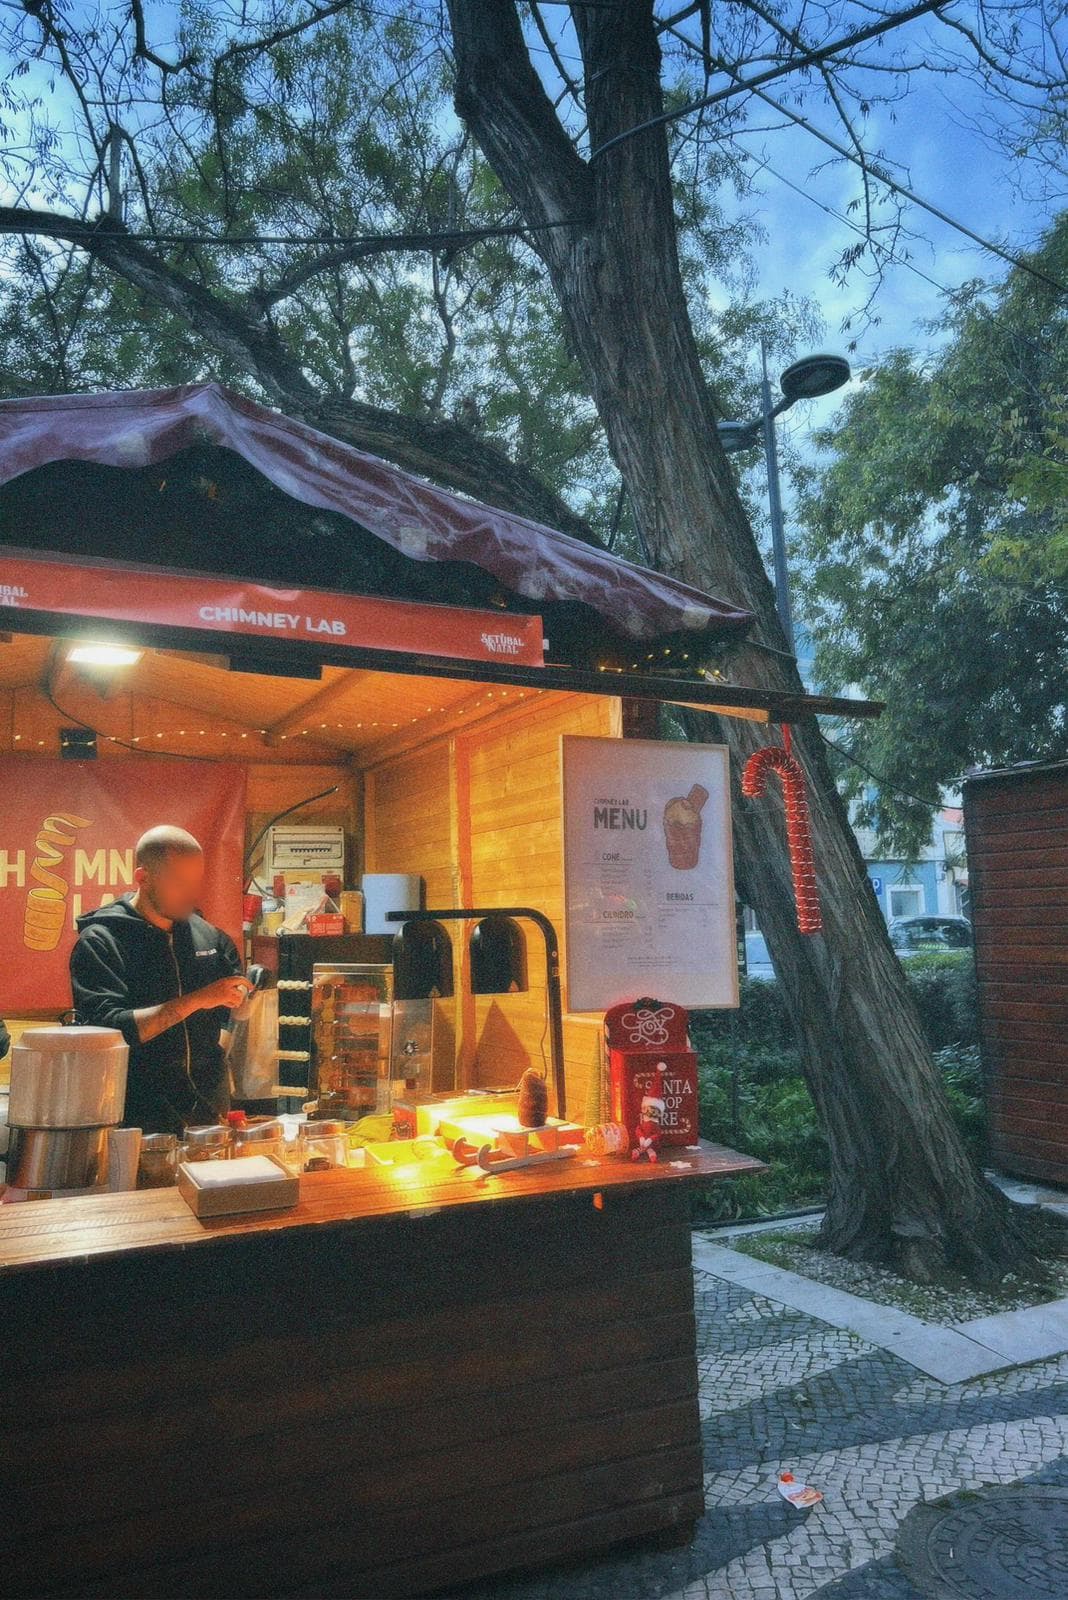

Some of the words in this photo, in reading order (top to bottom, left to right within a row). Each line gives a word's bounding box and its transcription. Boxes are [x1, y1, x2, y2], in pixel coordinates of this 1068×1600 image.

[199, 606, 301, 629] CHIMNEY
[305, 616, 347, 636] LAB
[593, 807, 648, 831] MENU
[872, 879, 880, 893] P
